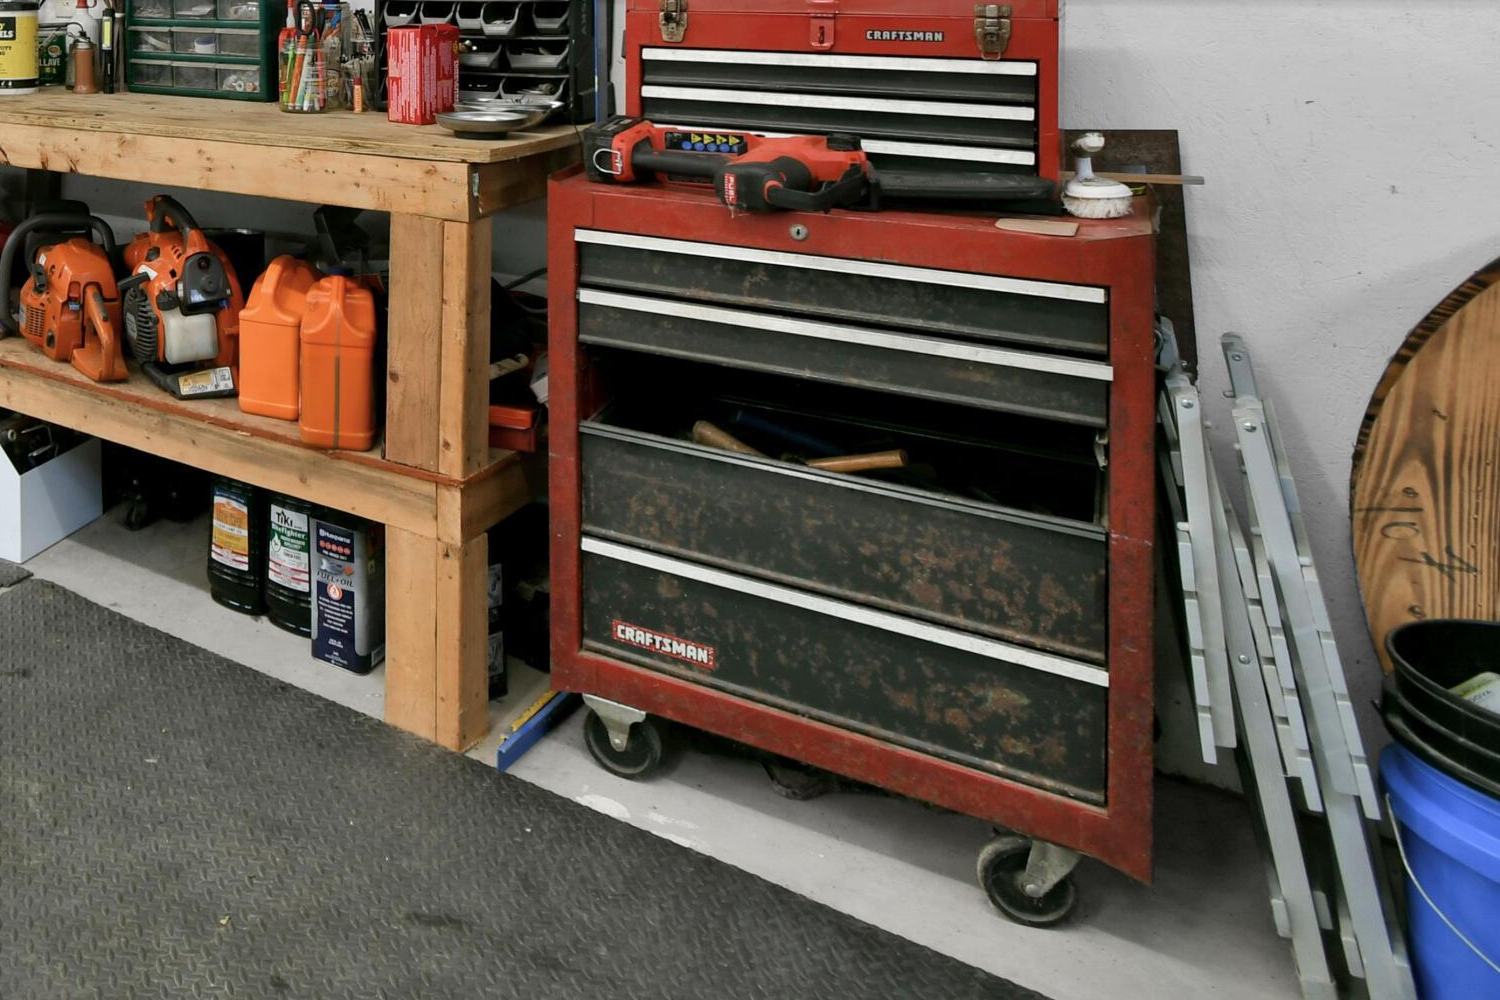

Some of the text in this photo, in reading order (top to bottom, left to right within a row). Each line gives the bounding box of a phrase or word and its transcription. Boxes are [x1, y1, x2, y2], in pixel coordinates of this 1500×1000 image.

[866, 30, 943, 41] CRAFTSMAN
[276, 510, 293, 527] TIKI
[617, 624, 709, 664] CRAFTSMAN
